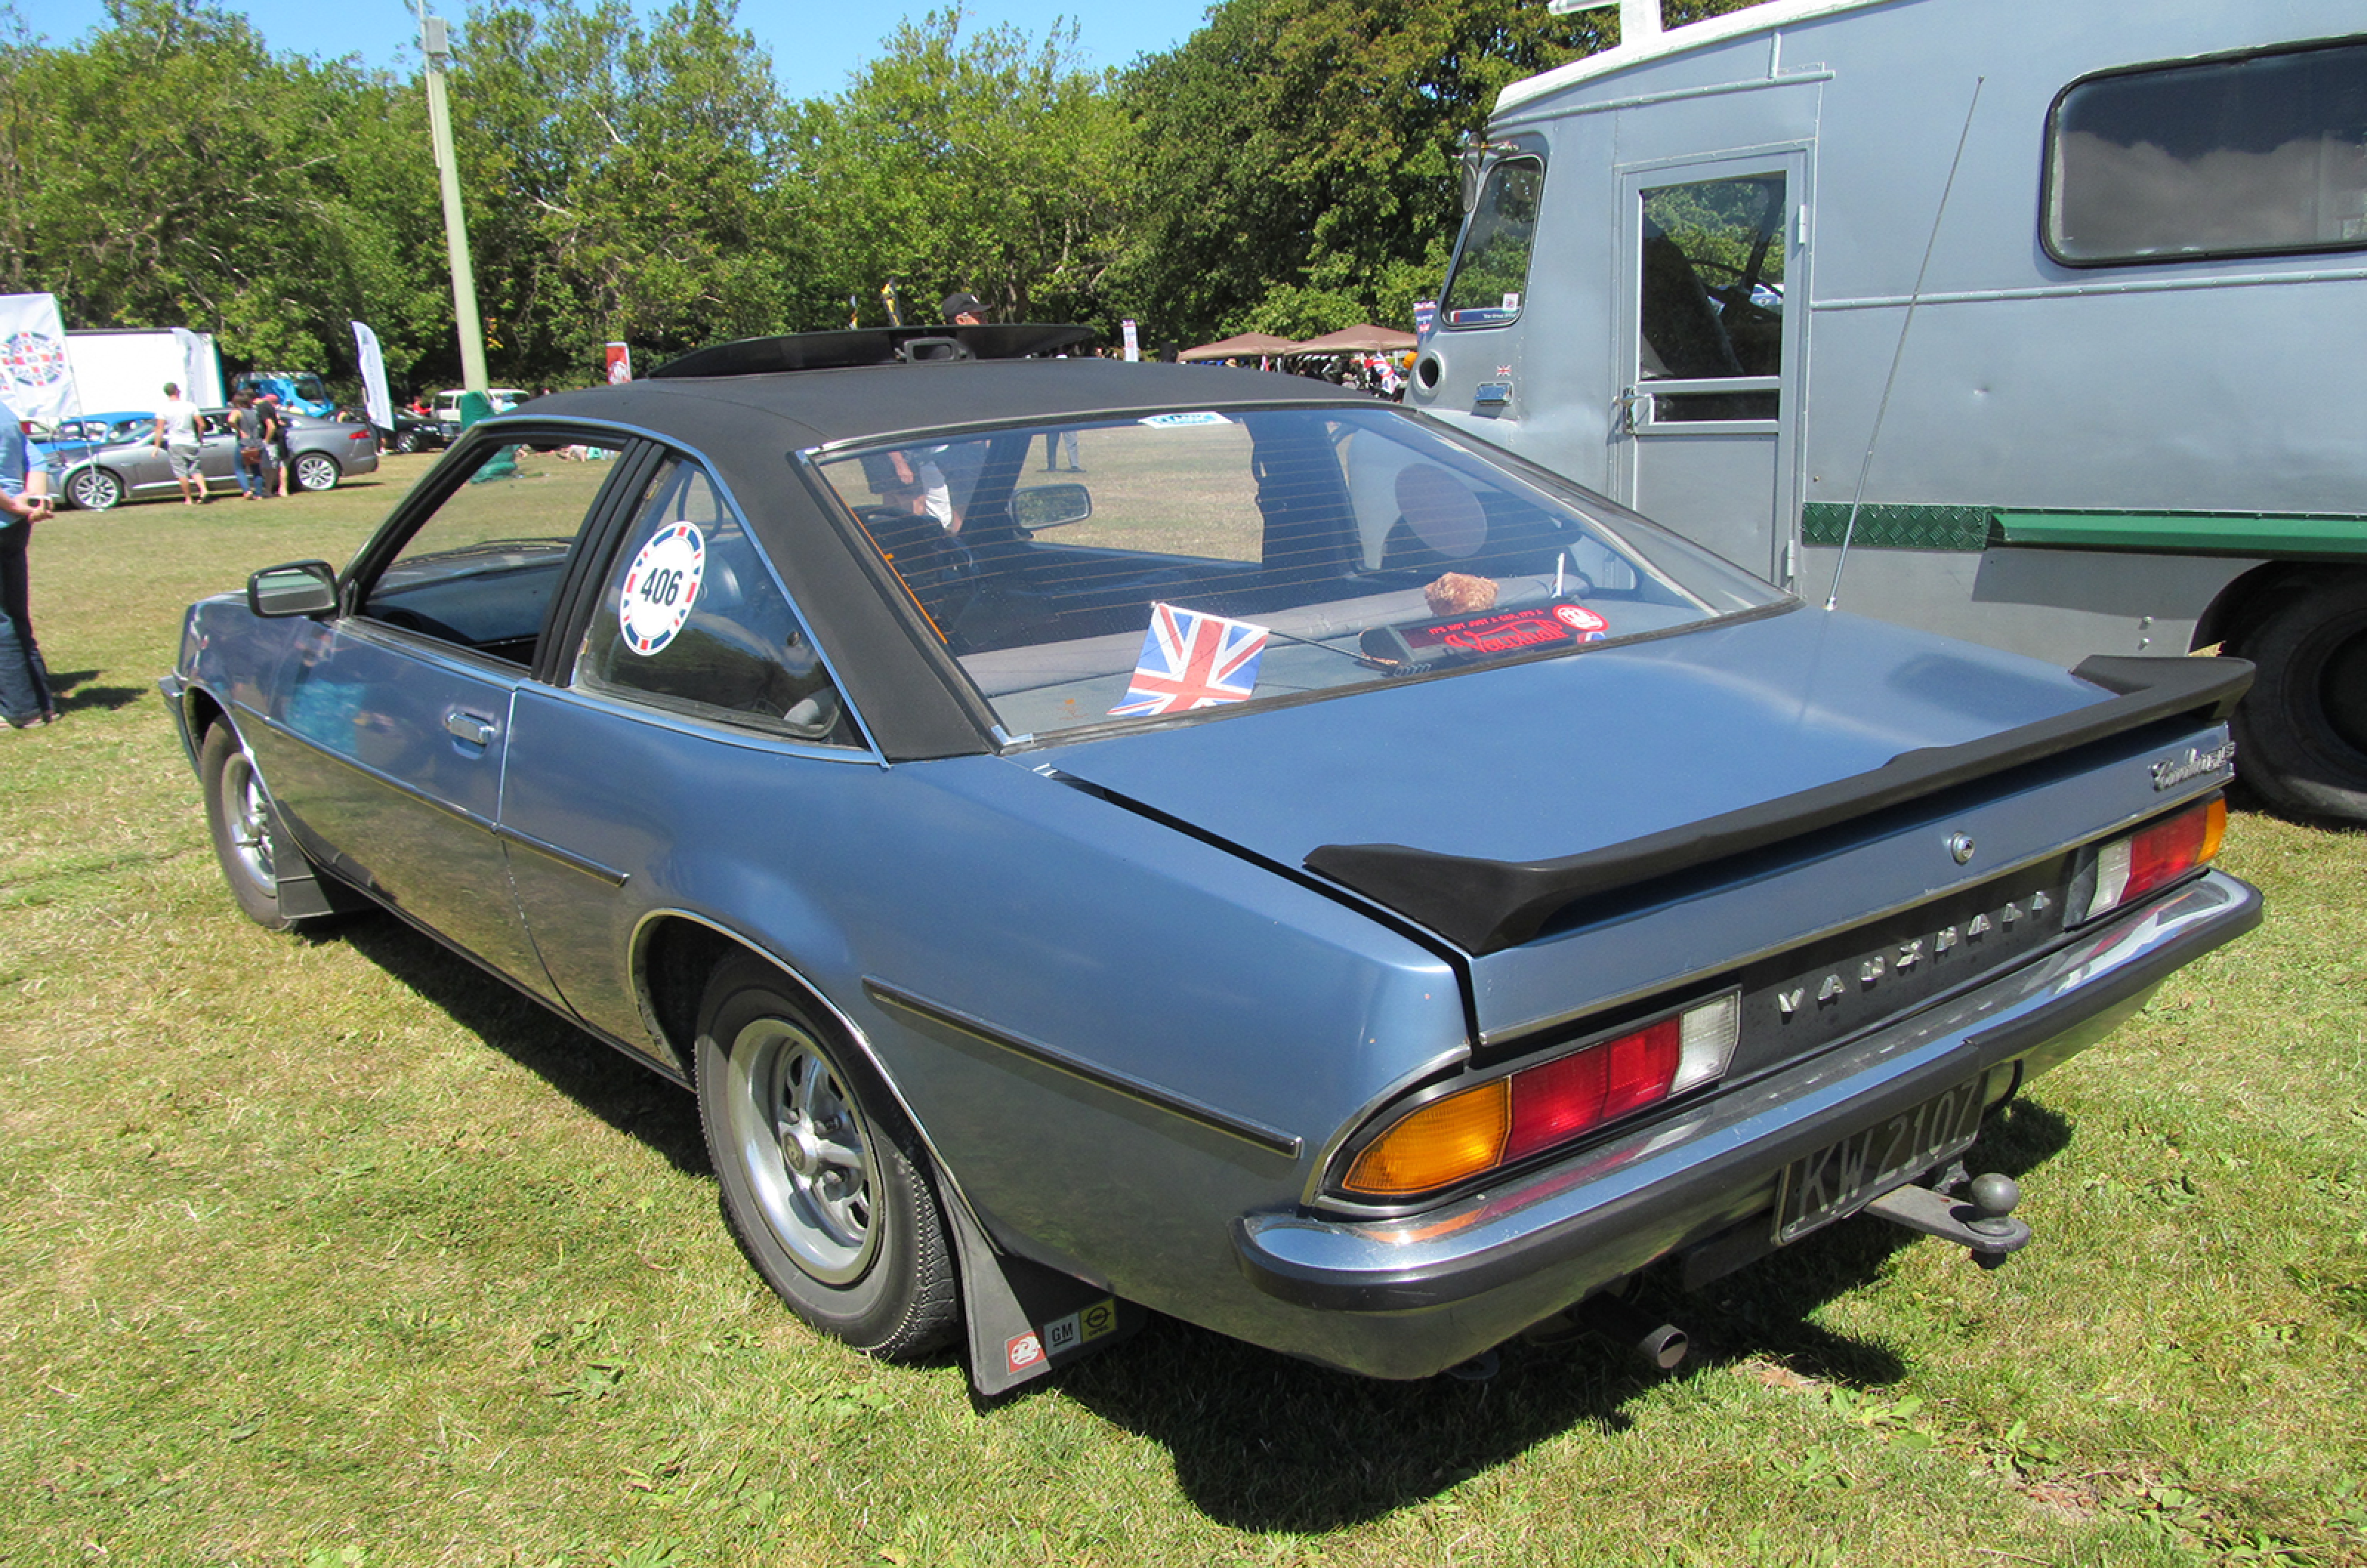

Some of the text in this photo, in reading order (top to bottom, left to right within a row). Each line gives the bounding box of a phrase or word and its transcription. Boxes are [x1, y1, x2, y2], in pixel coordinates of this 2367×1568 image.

[641, 567, 684, 607] 406
[1777, 890, 2051, 1013] VAUXHALL
[1051, 1322, 1073, 1343] GM
